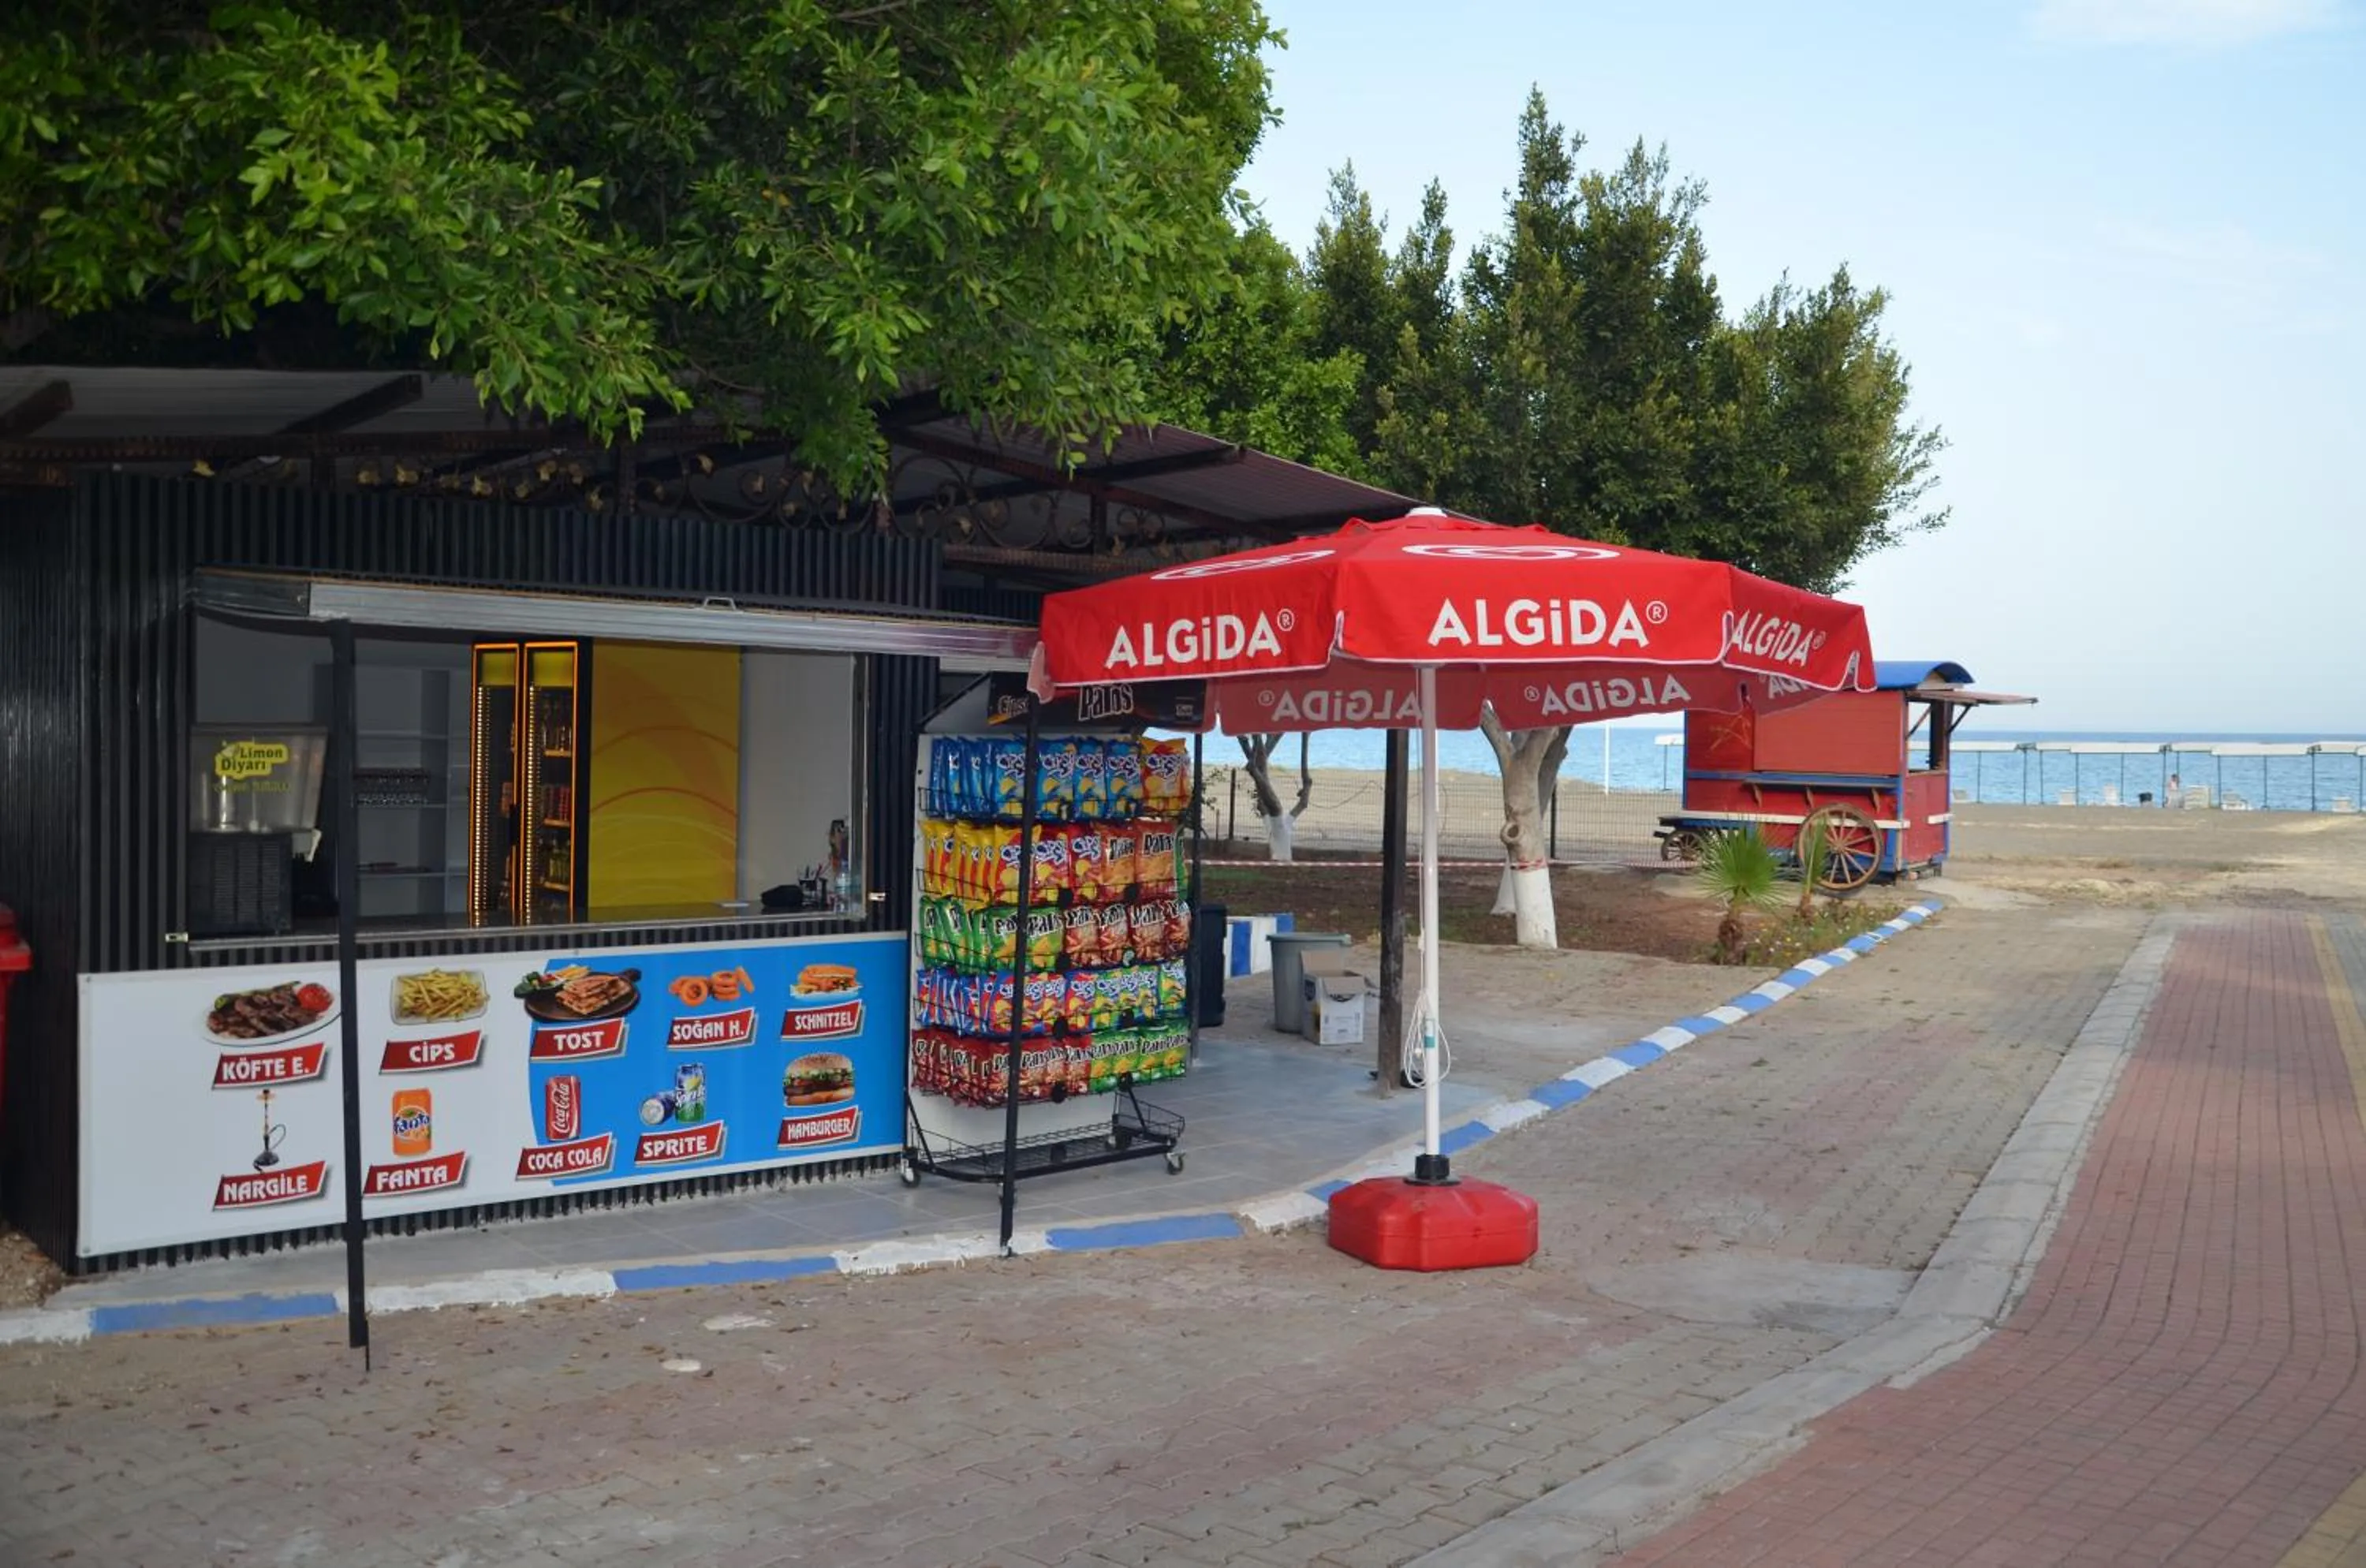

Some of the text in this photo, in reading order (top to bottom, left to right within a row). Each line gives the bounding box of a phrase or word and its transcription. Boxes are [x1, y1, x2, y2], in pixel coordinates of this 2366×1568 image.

[241, 747, 284, 759] Limon
[728, 1018, 745, 1038] H.
[794, 1010, 853, 1032] SCHNITZEL
[553, 1030, 605, 1051] TOST
[222, 1055, 311, 1081] KÖFTE E.
[787, 1117, 852, 1142] HAMBURGER
[527, 1146, 603, 1171] COCA COLA
[643, 1134, 707, 1159] SPRITE
[376, 1164, 448, 1192] FANTA
